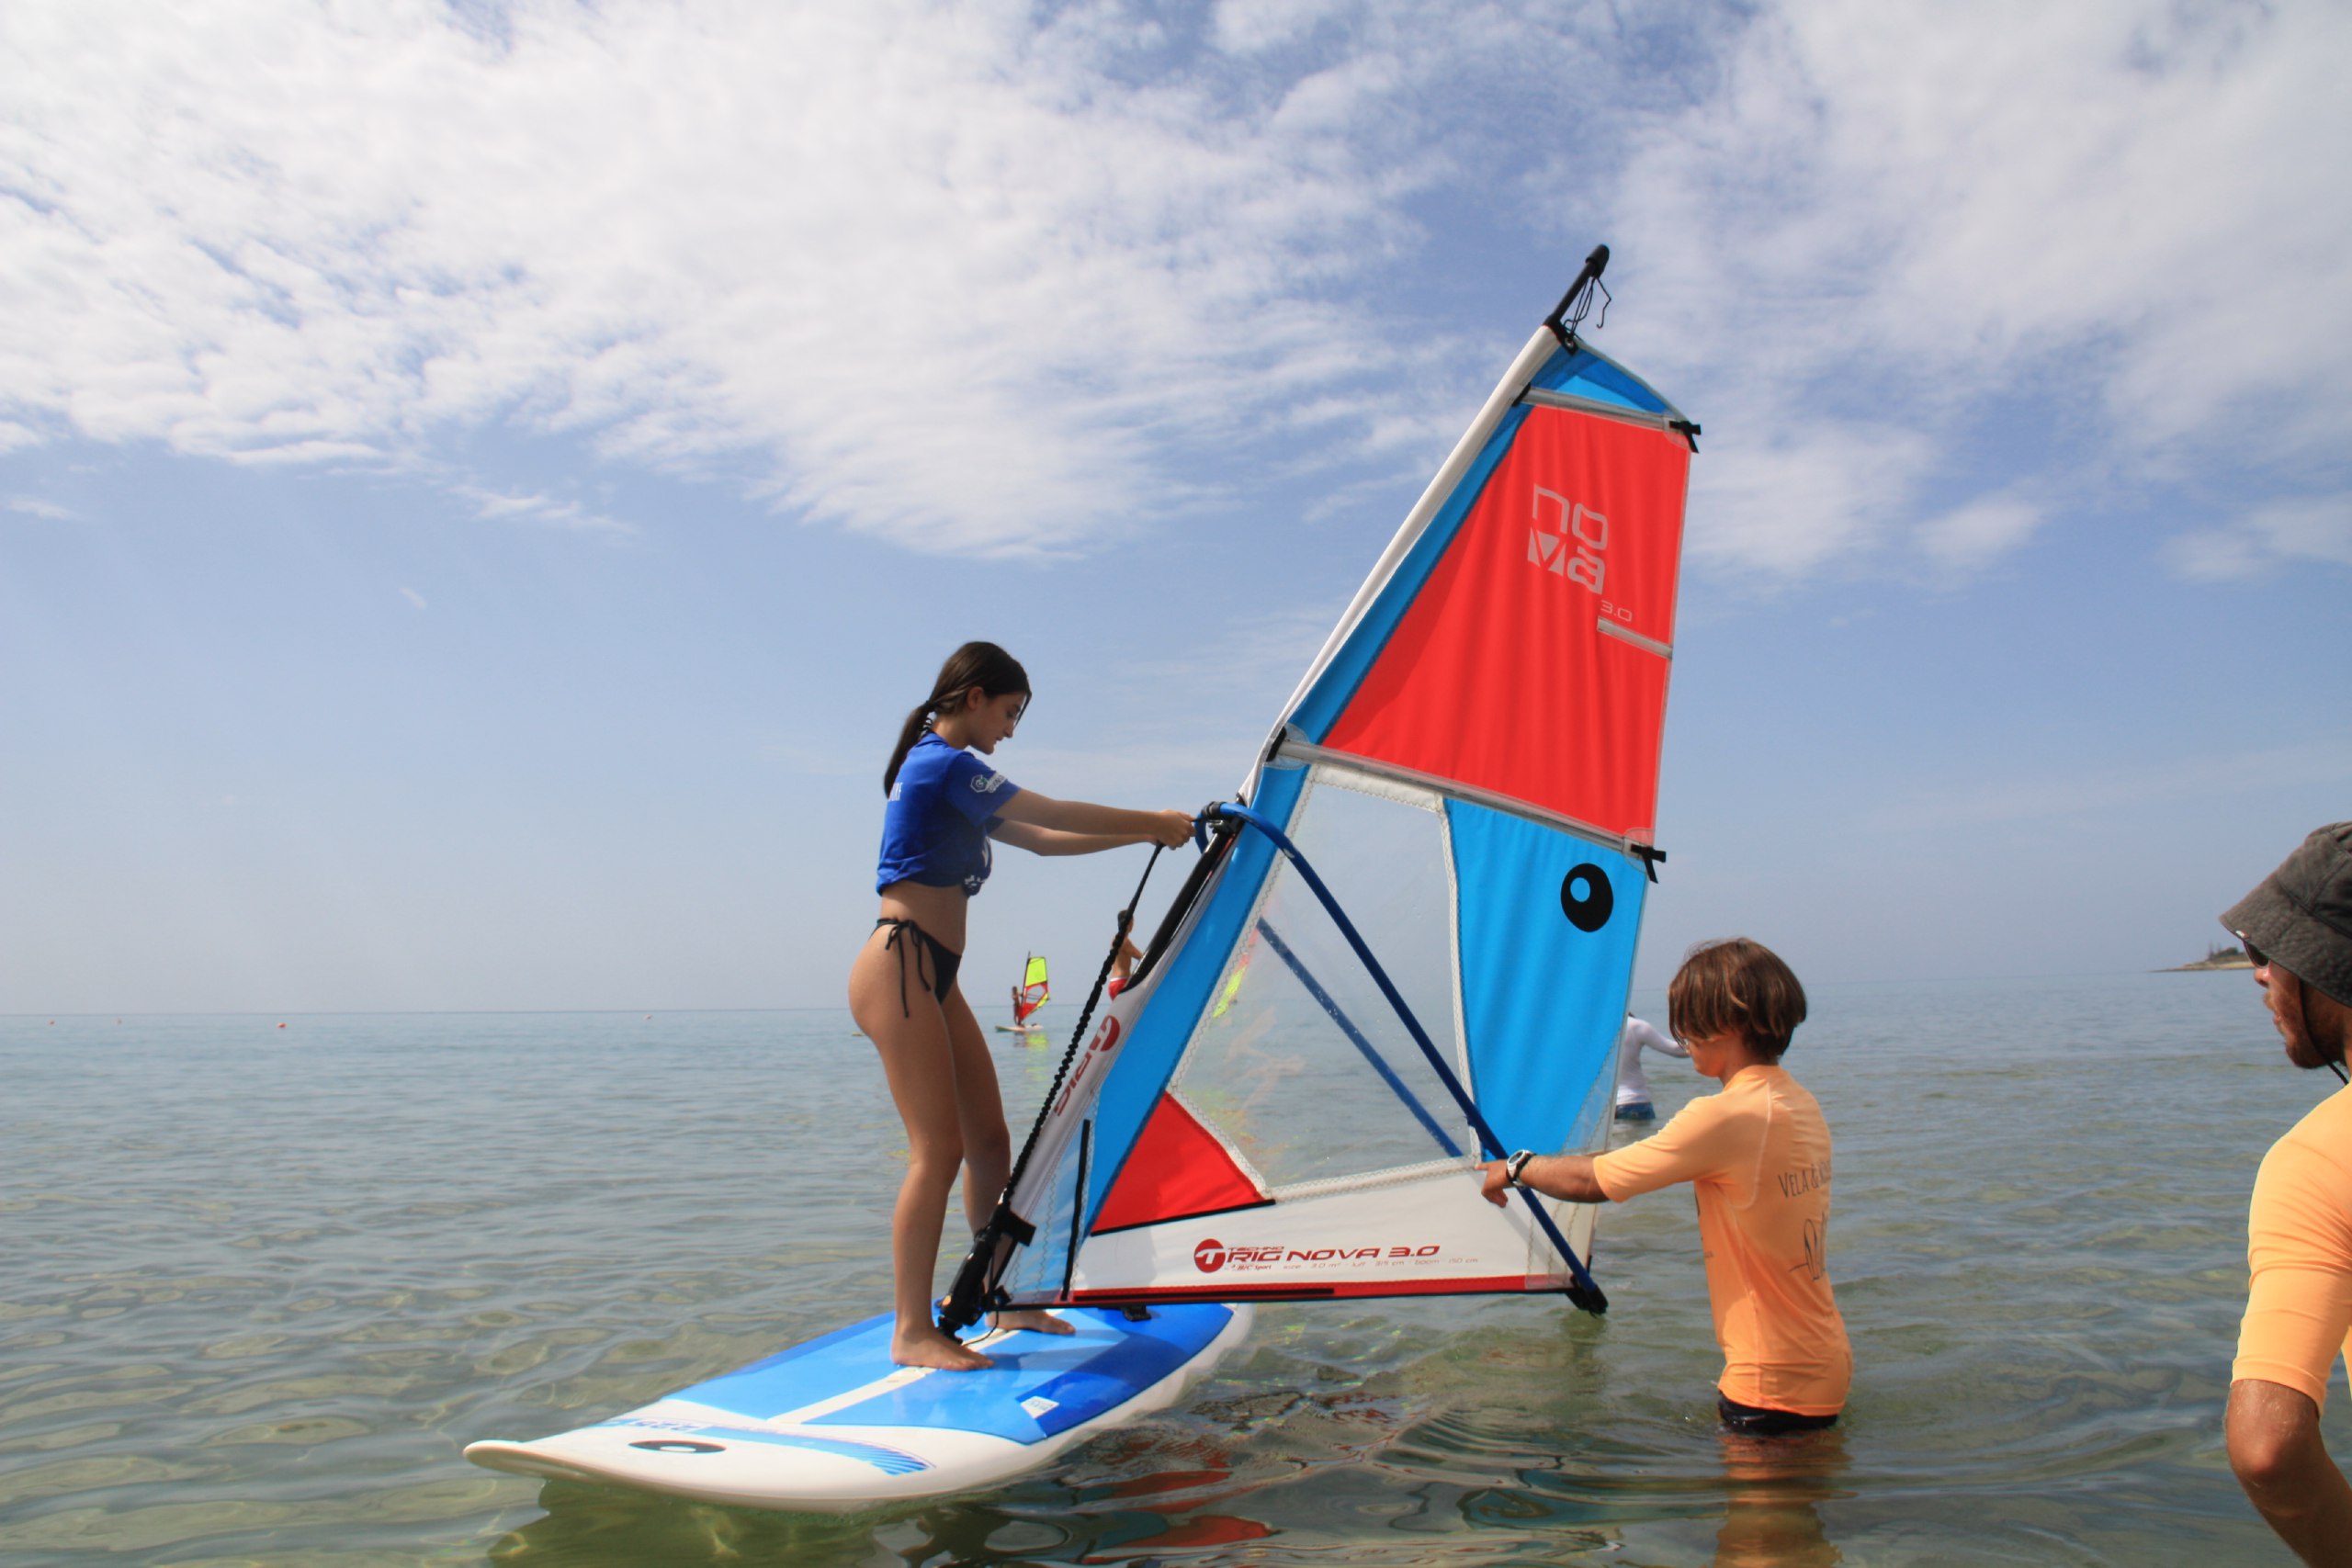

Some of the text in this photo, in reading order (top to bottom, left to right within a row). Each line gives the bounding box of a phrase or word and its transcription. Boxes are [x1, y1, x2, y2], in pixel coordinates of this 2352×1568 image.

[1600, 600, 1633, 622] 3.0
[1778, 1169, 1810, 1198] VELA
[1227, 1250, 1283, 1262] RIG
[1286, 1247, 1381, 1261] NOVA
[1388, 1246, 1441, 1258] 3.0
